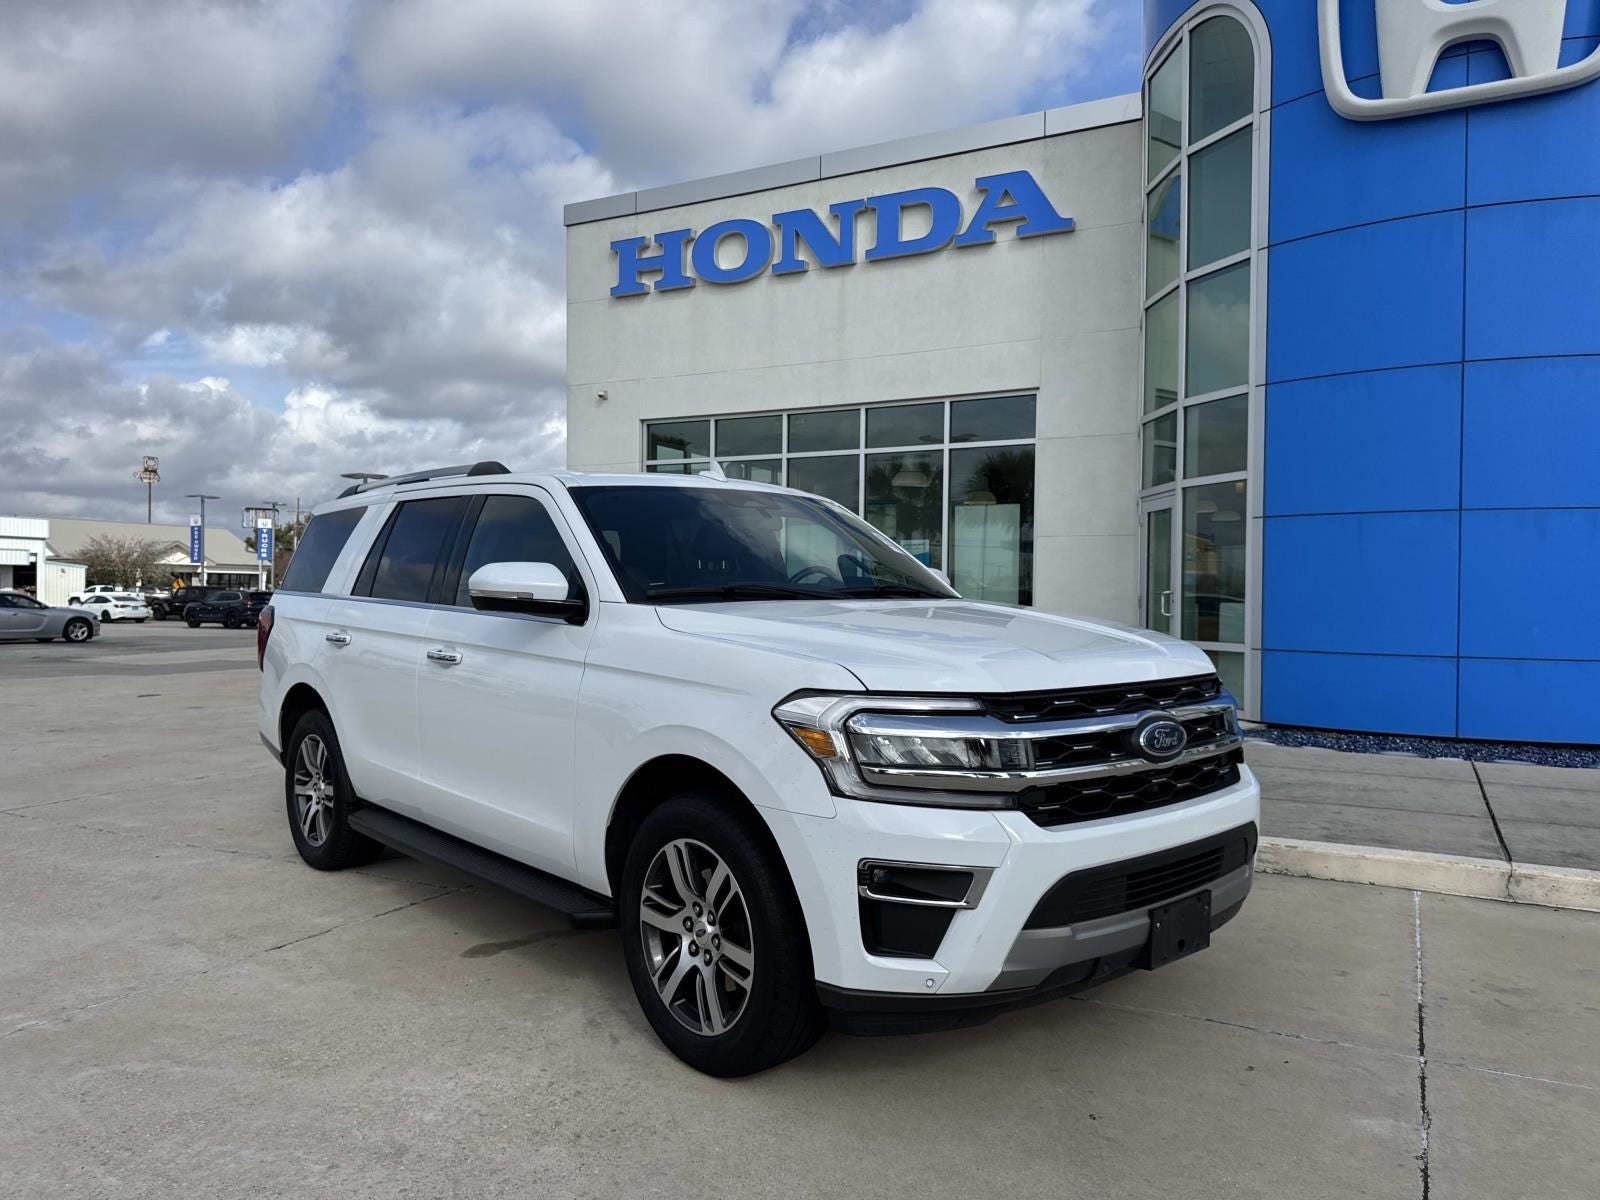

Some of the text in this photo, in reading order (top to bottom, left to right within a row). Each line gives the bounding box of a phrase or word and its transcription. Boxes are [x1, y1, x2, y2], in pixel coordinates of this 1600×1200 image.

[610, 170, 1075, 299] HONDA
[260, 528, 269, 558] TRUCKS
[1154, 728, 1178, 749] Ford
